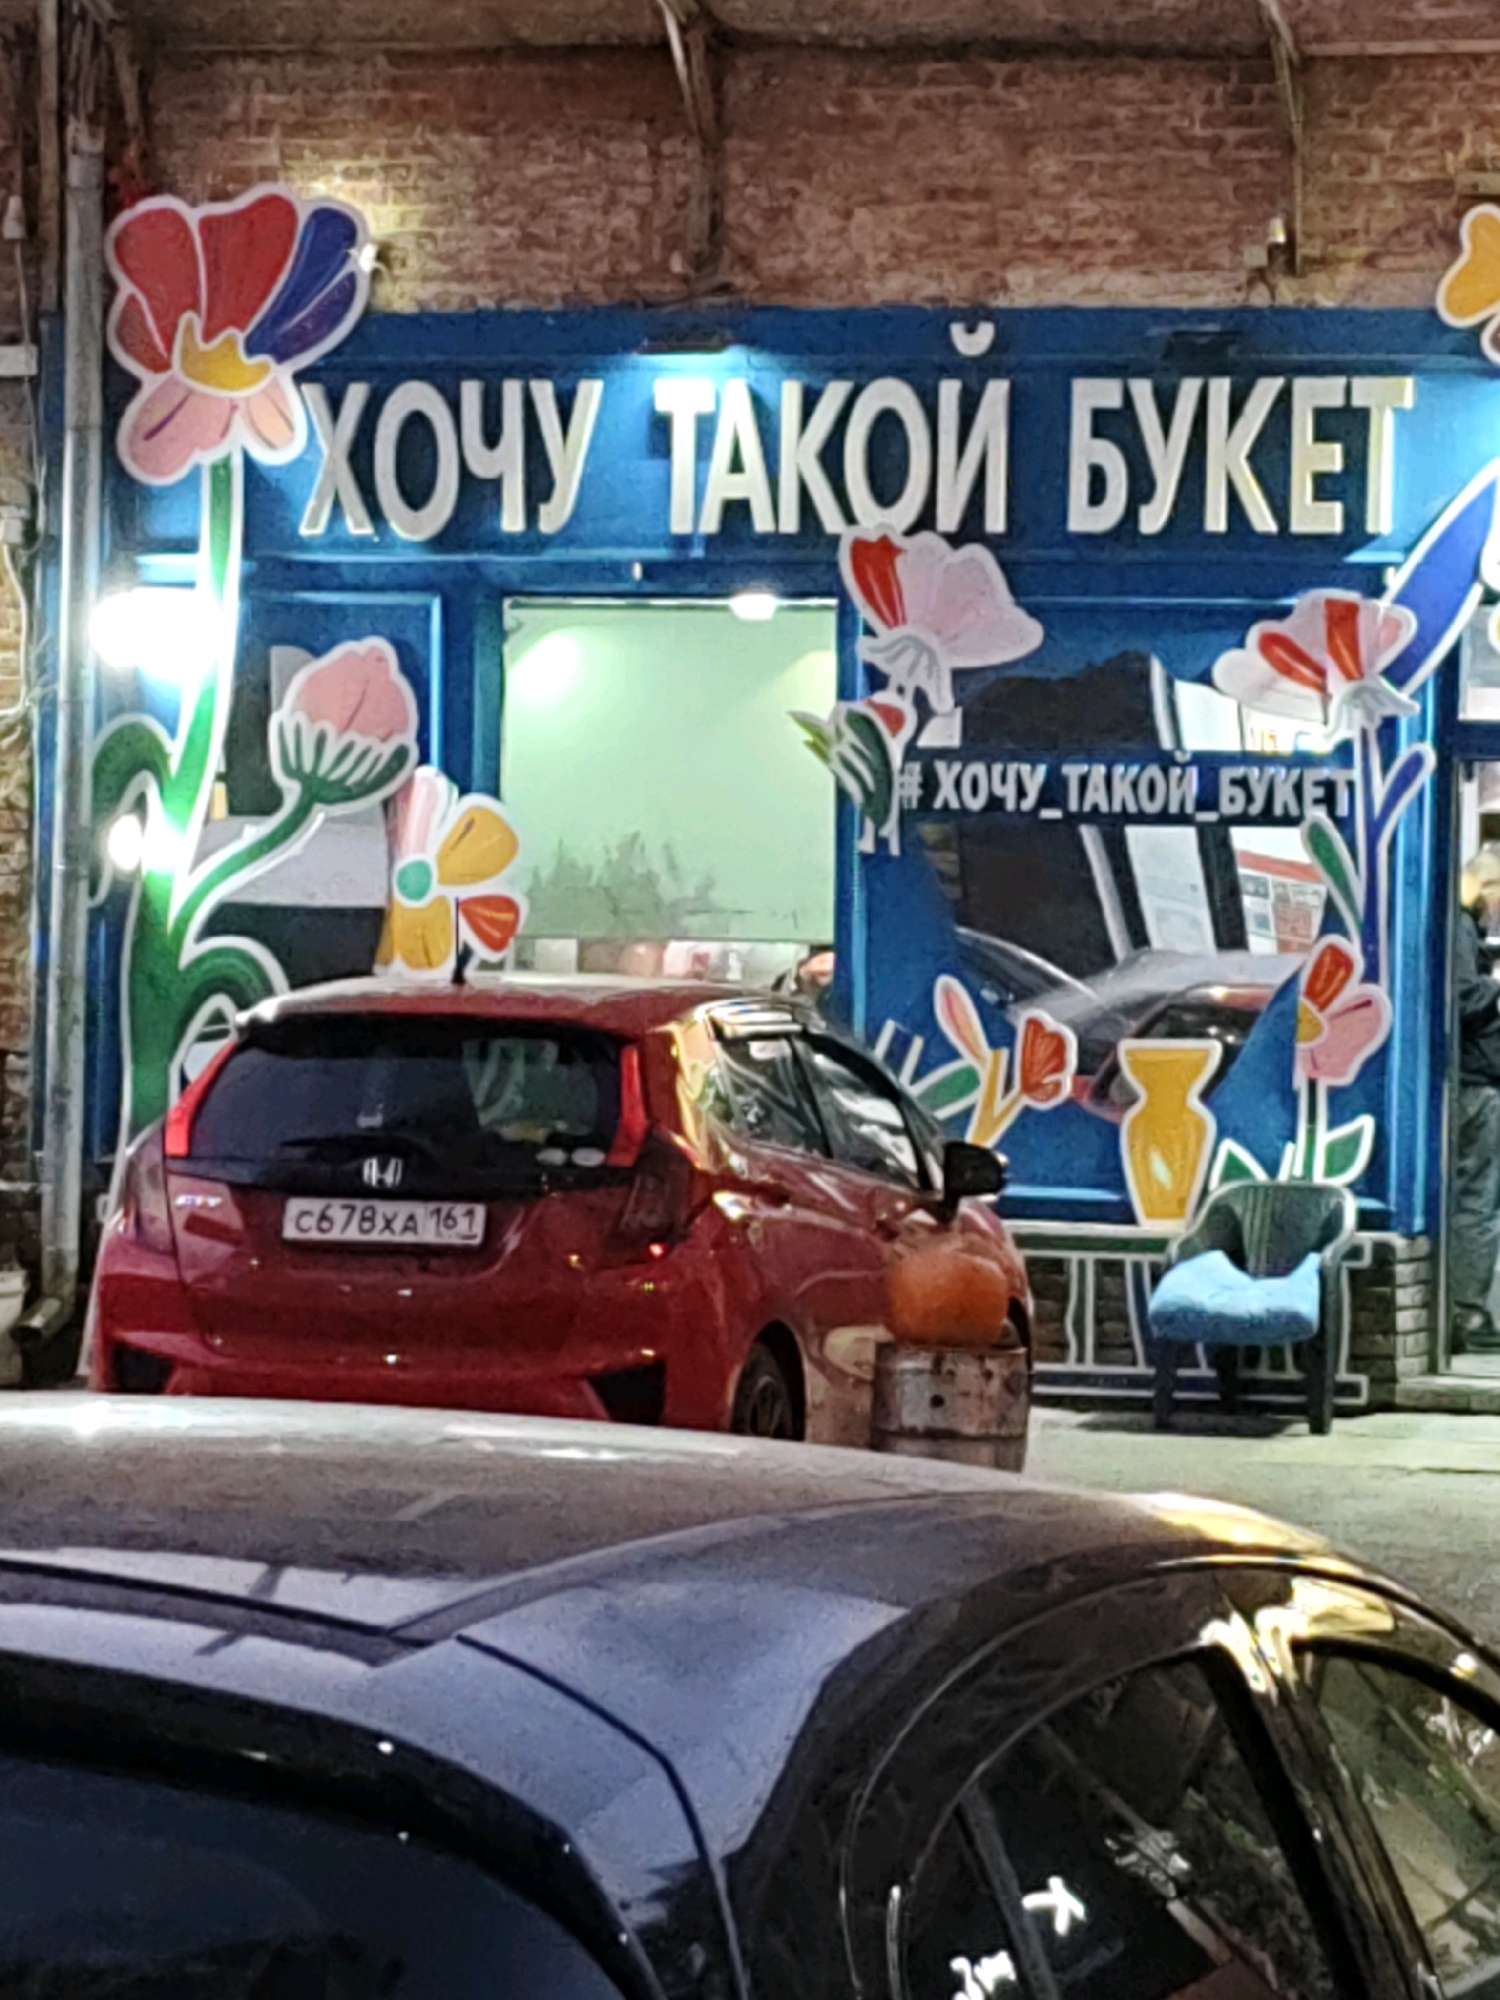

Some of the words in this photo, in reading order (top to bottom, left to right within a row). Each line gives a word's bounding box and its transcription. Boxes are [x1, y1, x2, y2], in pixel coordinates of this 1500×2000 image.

[299, 380, 604, 541] ХОЧУ
[653, 321, 1011, 534] ТАКОЙ
[1066, 376, 1414, 534] БУКЕТ
